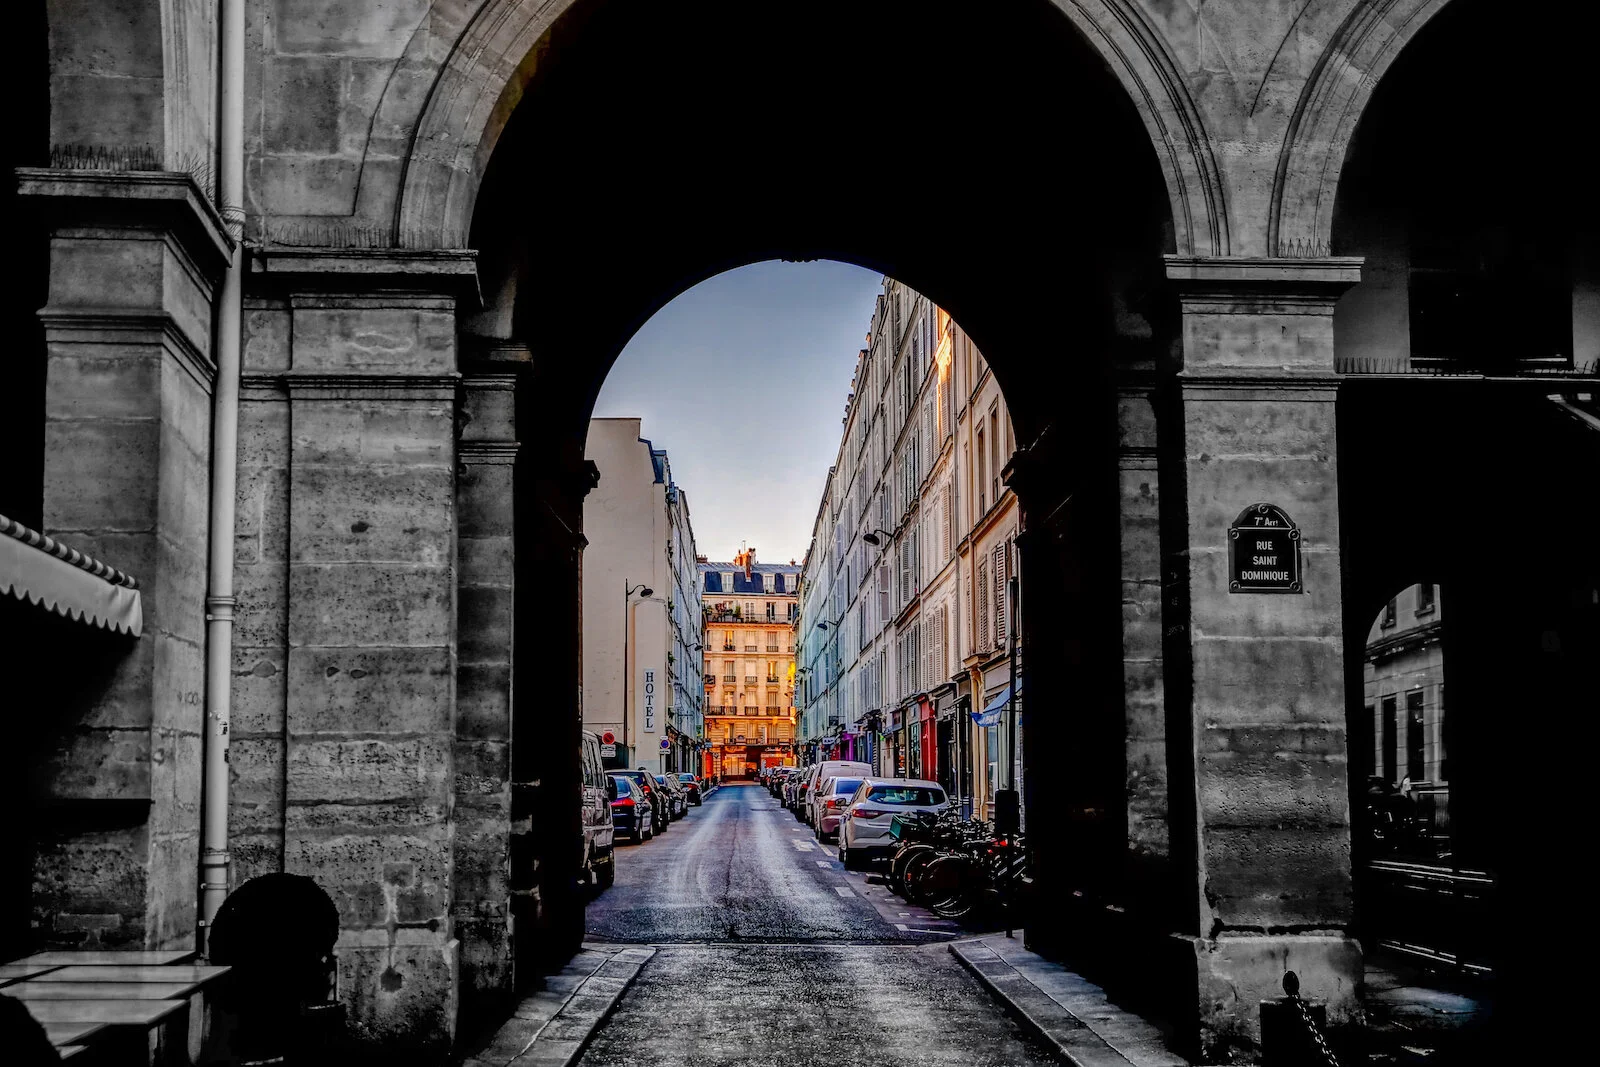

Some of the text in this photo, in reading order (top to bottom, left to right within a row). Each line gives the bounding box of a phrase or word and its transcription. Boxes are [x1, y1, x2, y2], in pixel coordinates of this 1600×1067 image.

[1256, 541, 1273, 550] RUE
[1252, 556, 1277, 565] SAINT
[1241, 571, 1289, 581] DOMINIQUE
[645, 671, 654, 729] HOTEL
